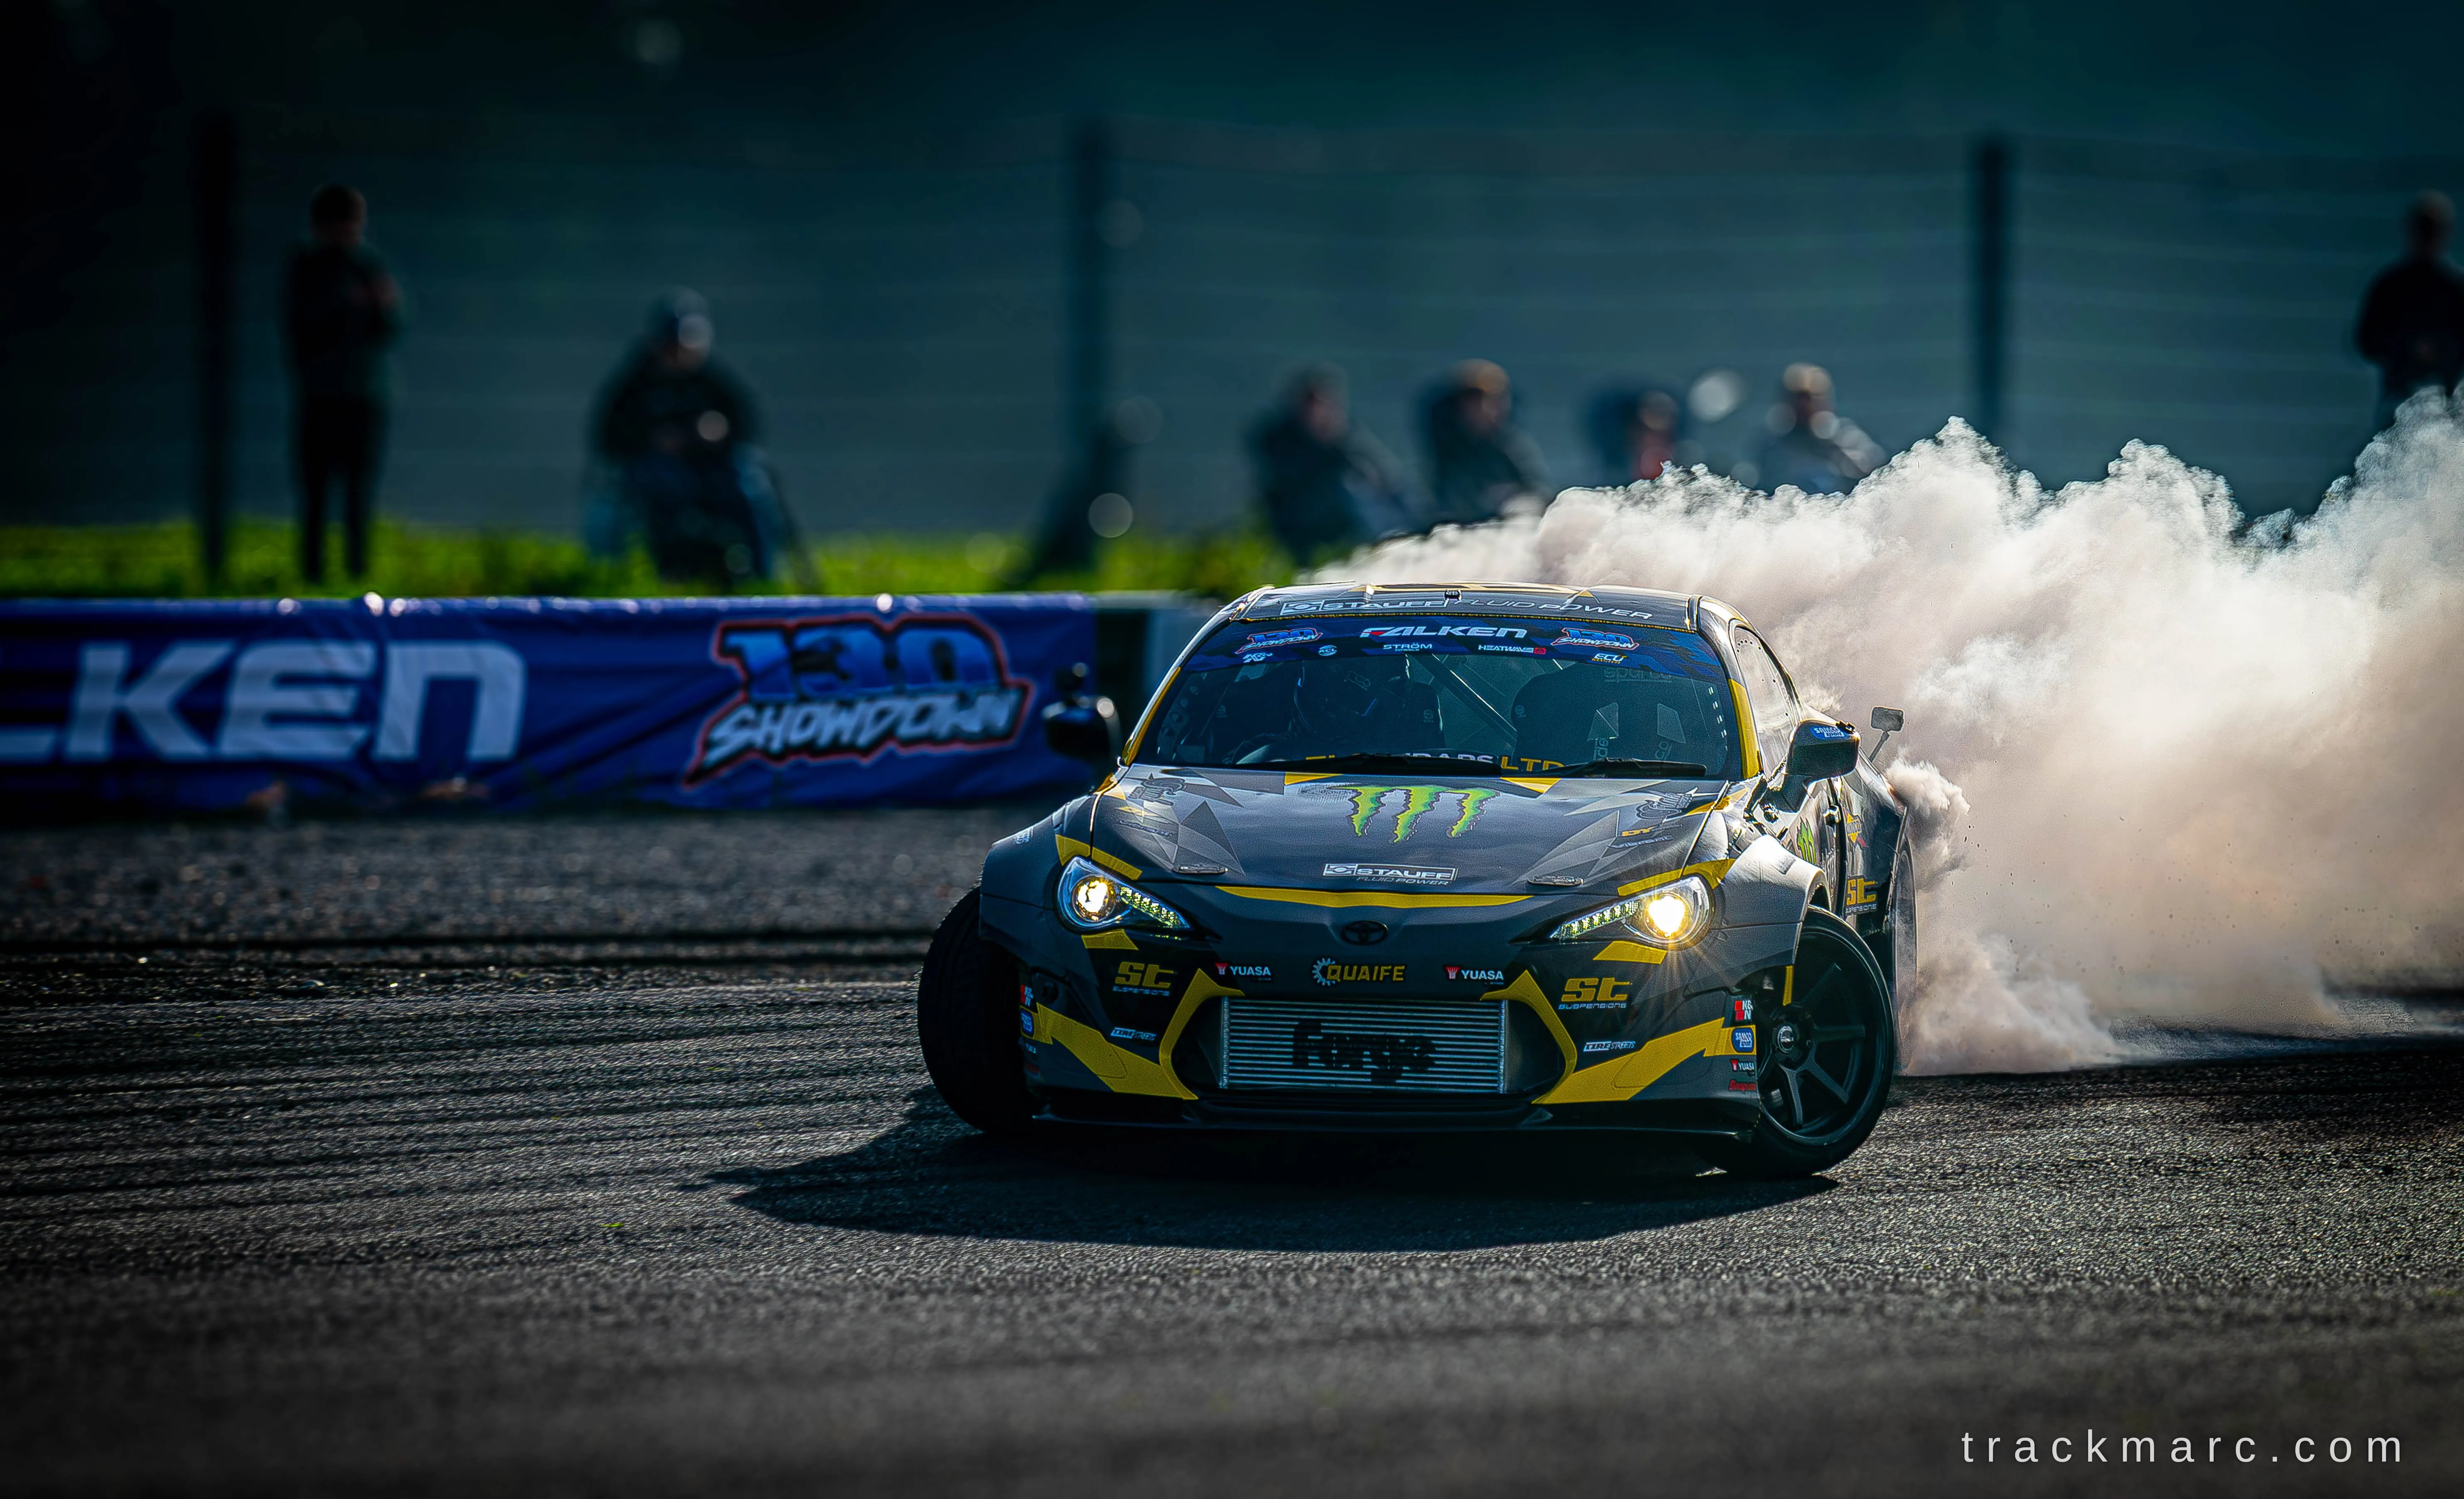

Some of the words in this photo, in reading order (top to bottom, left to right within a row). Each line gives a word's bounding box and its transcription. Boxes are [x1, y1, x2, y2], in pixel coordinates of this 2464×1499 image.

[1454, 599, 1535, 608] FLUID
[1538, 603, 1654, 619] POWER
[1359, 626, 1528, 638] FALKEN
[1558, 637, 1635, 648] SHOWDOWN
[1478, 645, 1534, 653] HEATWAVE
[1594, 653, 1624, 662] ECU
[723, 627, 1000, 703] 130
[703, 688, 1021, 769] SHOWDOWN
[1501, 756, 1564, 772] LTD
[1356, 868, 1452, 879] STAUFF
[1230, 966, 1272, 976] YUASA
[1326, 965, 1405, 982] QUAIFE
[1461, 969, 1504, 981] YUASA
